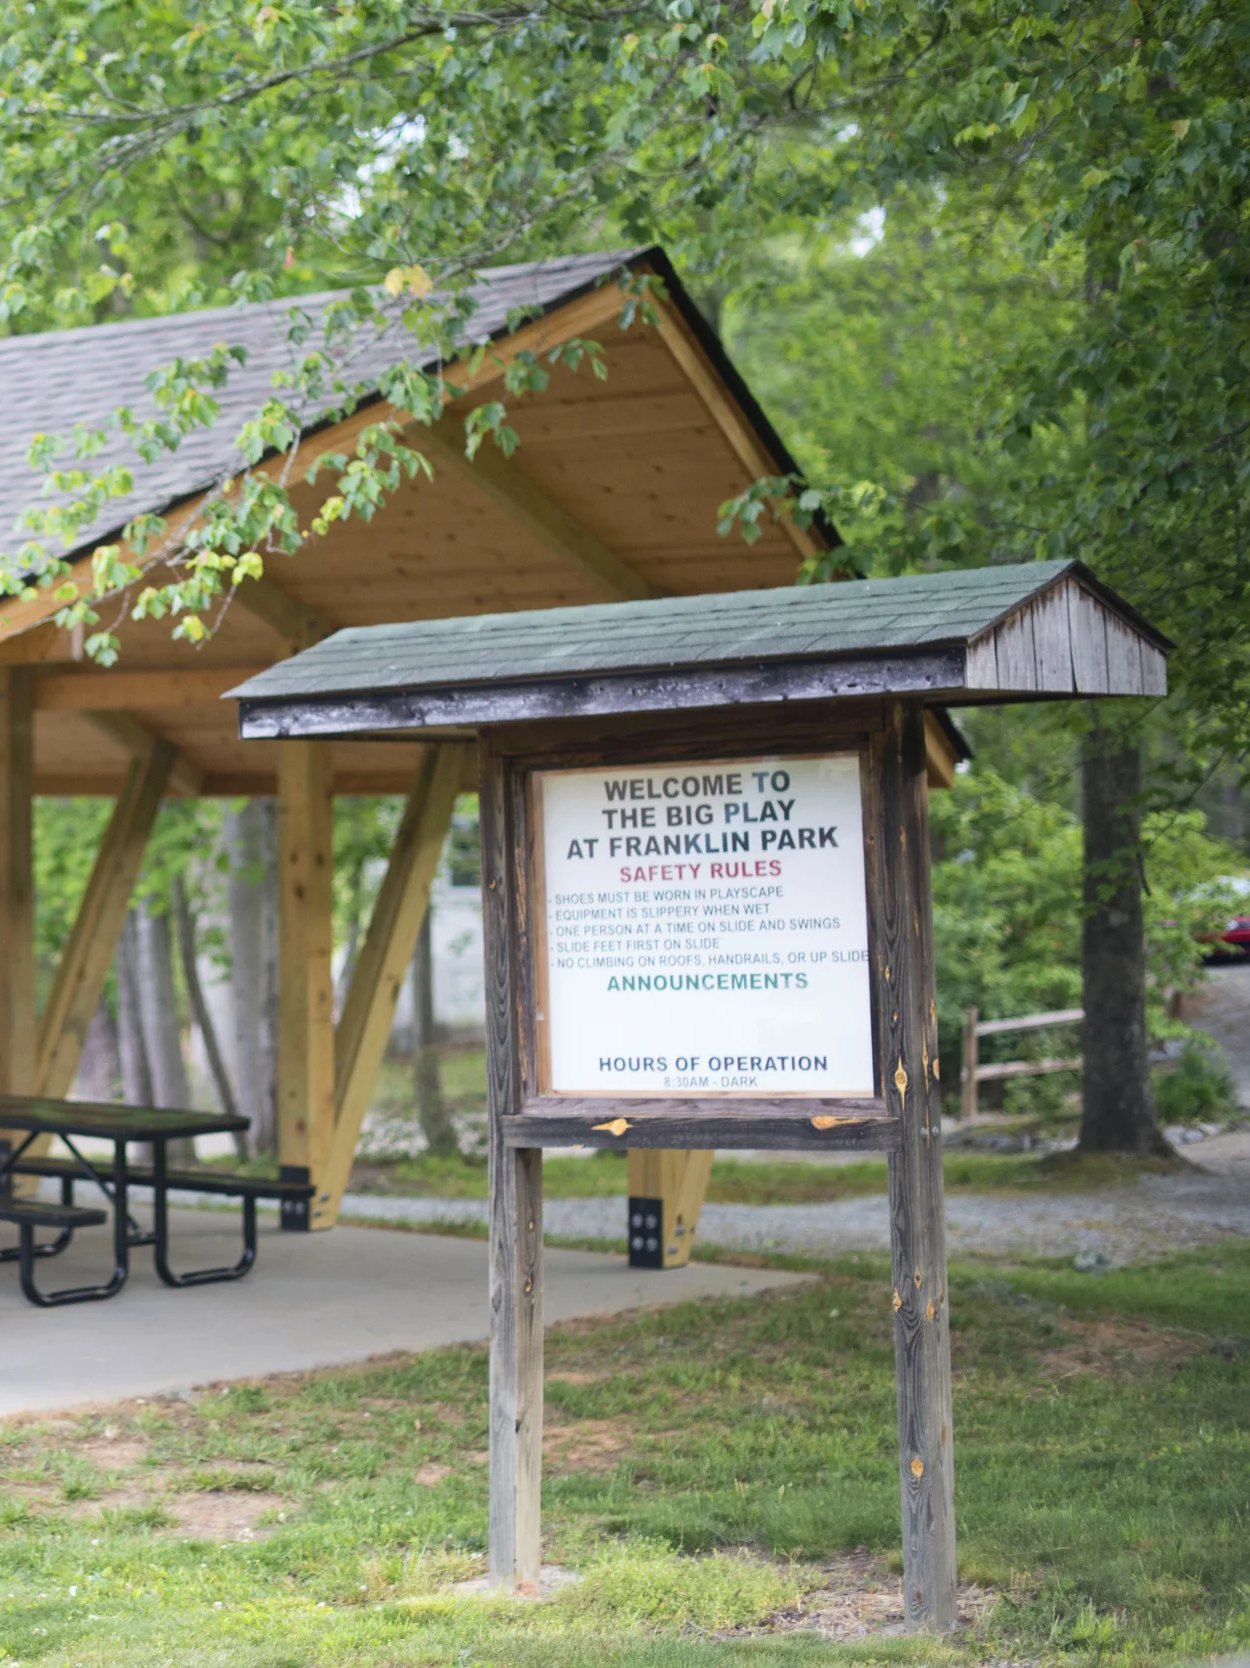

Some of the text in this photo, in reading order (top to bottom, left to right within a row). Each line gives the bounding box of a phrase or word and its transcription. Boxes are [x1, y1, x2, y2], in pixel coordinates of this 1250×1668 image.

[604, 770, 791, 802] WELCOME TO
[602, 798, 796, 830] THE BIG PLAY
[566, 825, 839, 860] AT FRANKLIN PARK
[620, 859, 782, 883] SAFETY RULES
[555, 893, 594, 905] SHOES
[598, 891, 631, 904] MUST
[634, 890, 650, 903] BE
[653, 889, 691, 902] WORN
[694, 889, 706, 900] IN
[710, 885, 784, 900] PLAYSCAPE
[556, 908, 623, 921] EQUIPMENT
[626, 907, 638, 919] IS
[642, 905, 699, 919] SLIPPERY
[703, 904, 740, 916] WHEN
[743, 903, 770, 916] WET
[556, 925, 580, 937] ONE
[584, 924, 632, 936] PERSON
[636, 923, 651, 935] AT
[654, 923, 662, 934] A
[666, 921, 694, 934] TIME
[698, 920, 716, 933] ON
[719, 919, 755, 932] SLIDE
[759, 918, 785, 931] AND
[790, 917, 841, 930] SWINGS
[557, 941, 590, 953] SLIDE
[594, 940, 623, 953] FEET
[626, 939, 660, 952] FIRST
[663, 939, 681, 951] ON
[685, 937, 719, 950] SLIDE
[558, 957, 574, 969] NO
[578, 956, 634, 969] CLIMBING
[638, 956, 655, 968] ON
[788, 952, 806, 964] OR
[810, 951, 827, 963] UP
[607, 972, 809, 992] ANNOUNCEMENTS
[599, 1055, 829, 1073] HOURS OF OPERATION
[664, 1076, 709, 1088] 8:30AM
[721, 1076, 758, 1088] DARK
